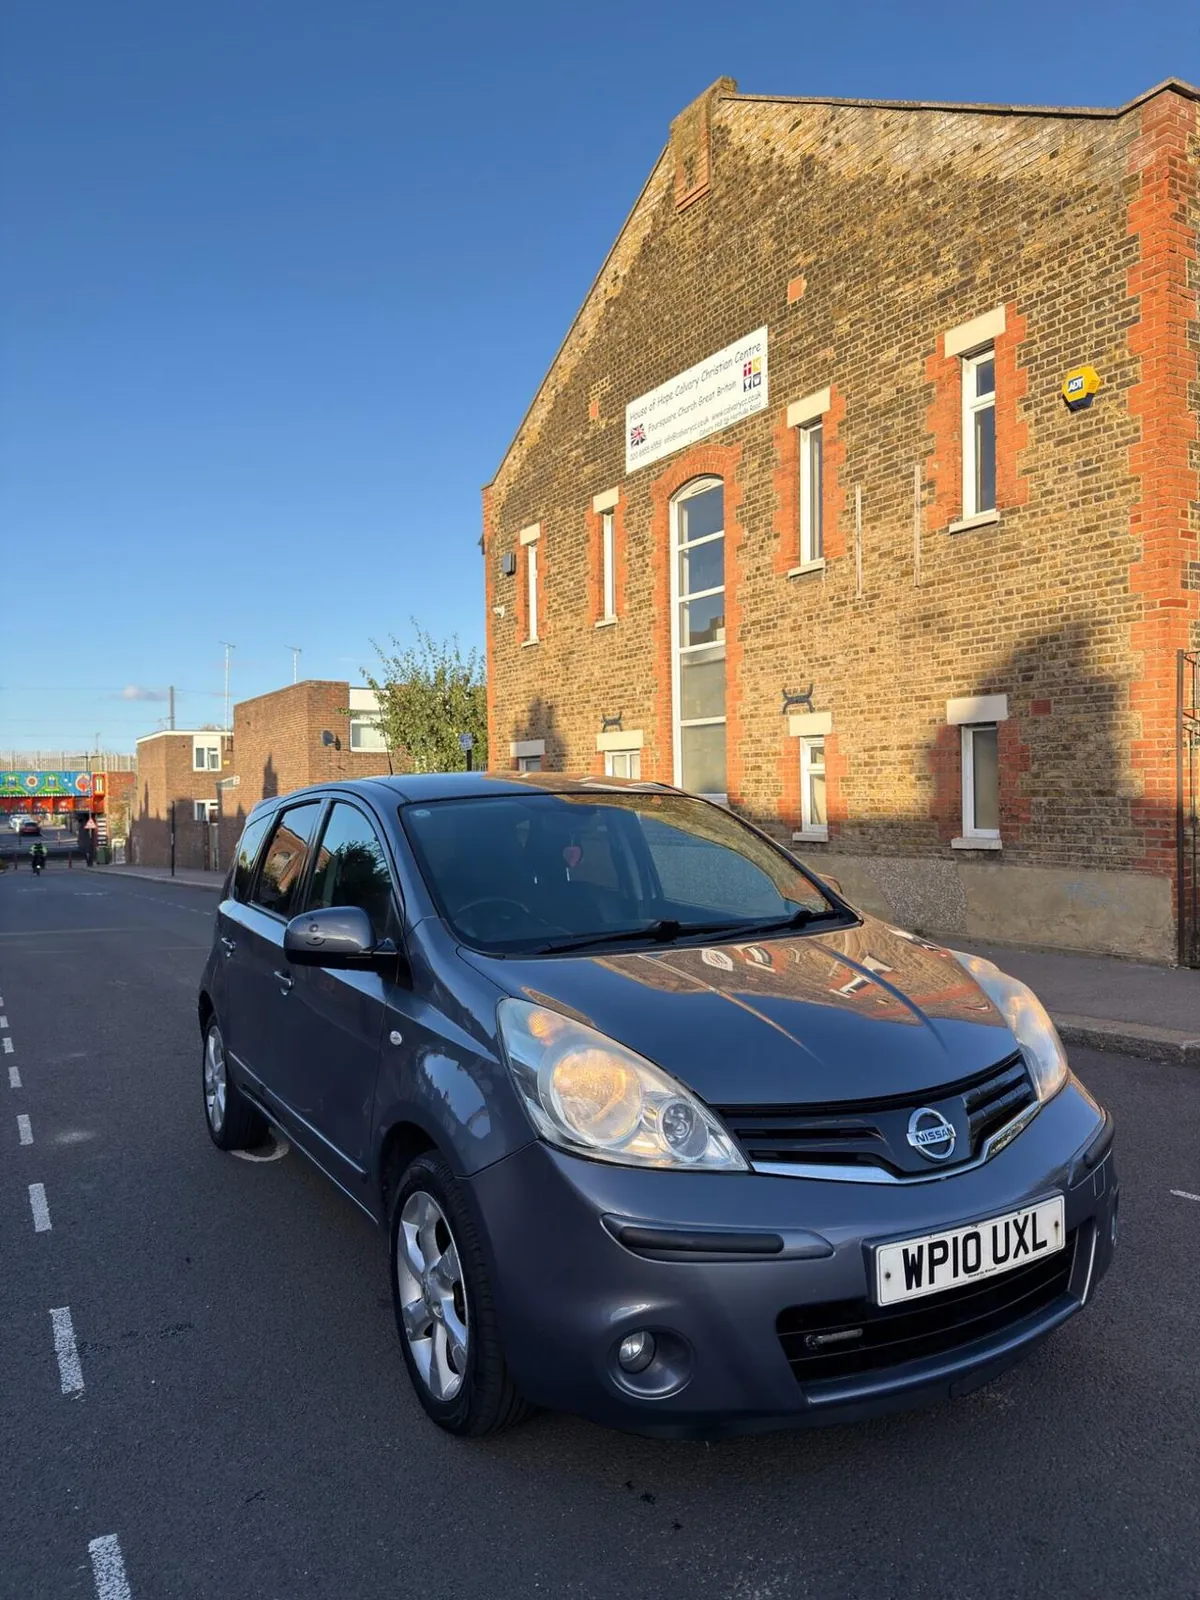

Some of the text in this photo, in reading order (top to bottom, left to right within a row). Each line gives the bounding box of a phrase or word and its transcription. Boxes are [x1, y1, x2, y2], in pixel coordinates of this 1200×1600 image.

[630, 343, 761, 422] House of Hope Calvary Christian Centre
[648, 380, 737, 432] Foursquare Church Great Britain
[1068, 377, 1083, 392] ADT
[915, 1127, 953, 1143] NISSAN
[902, 1212, 1048, 1291] WP10 UXL
